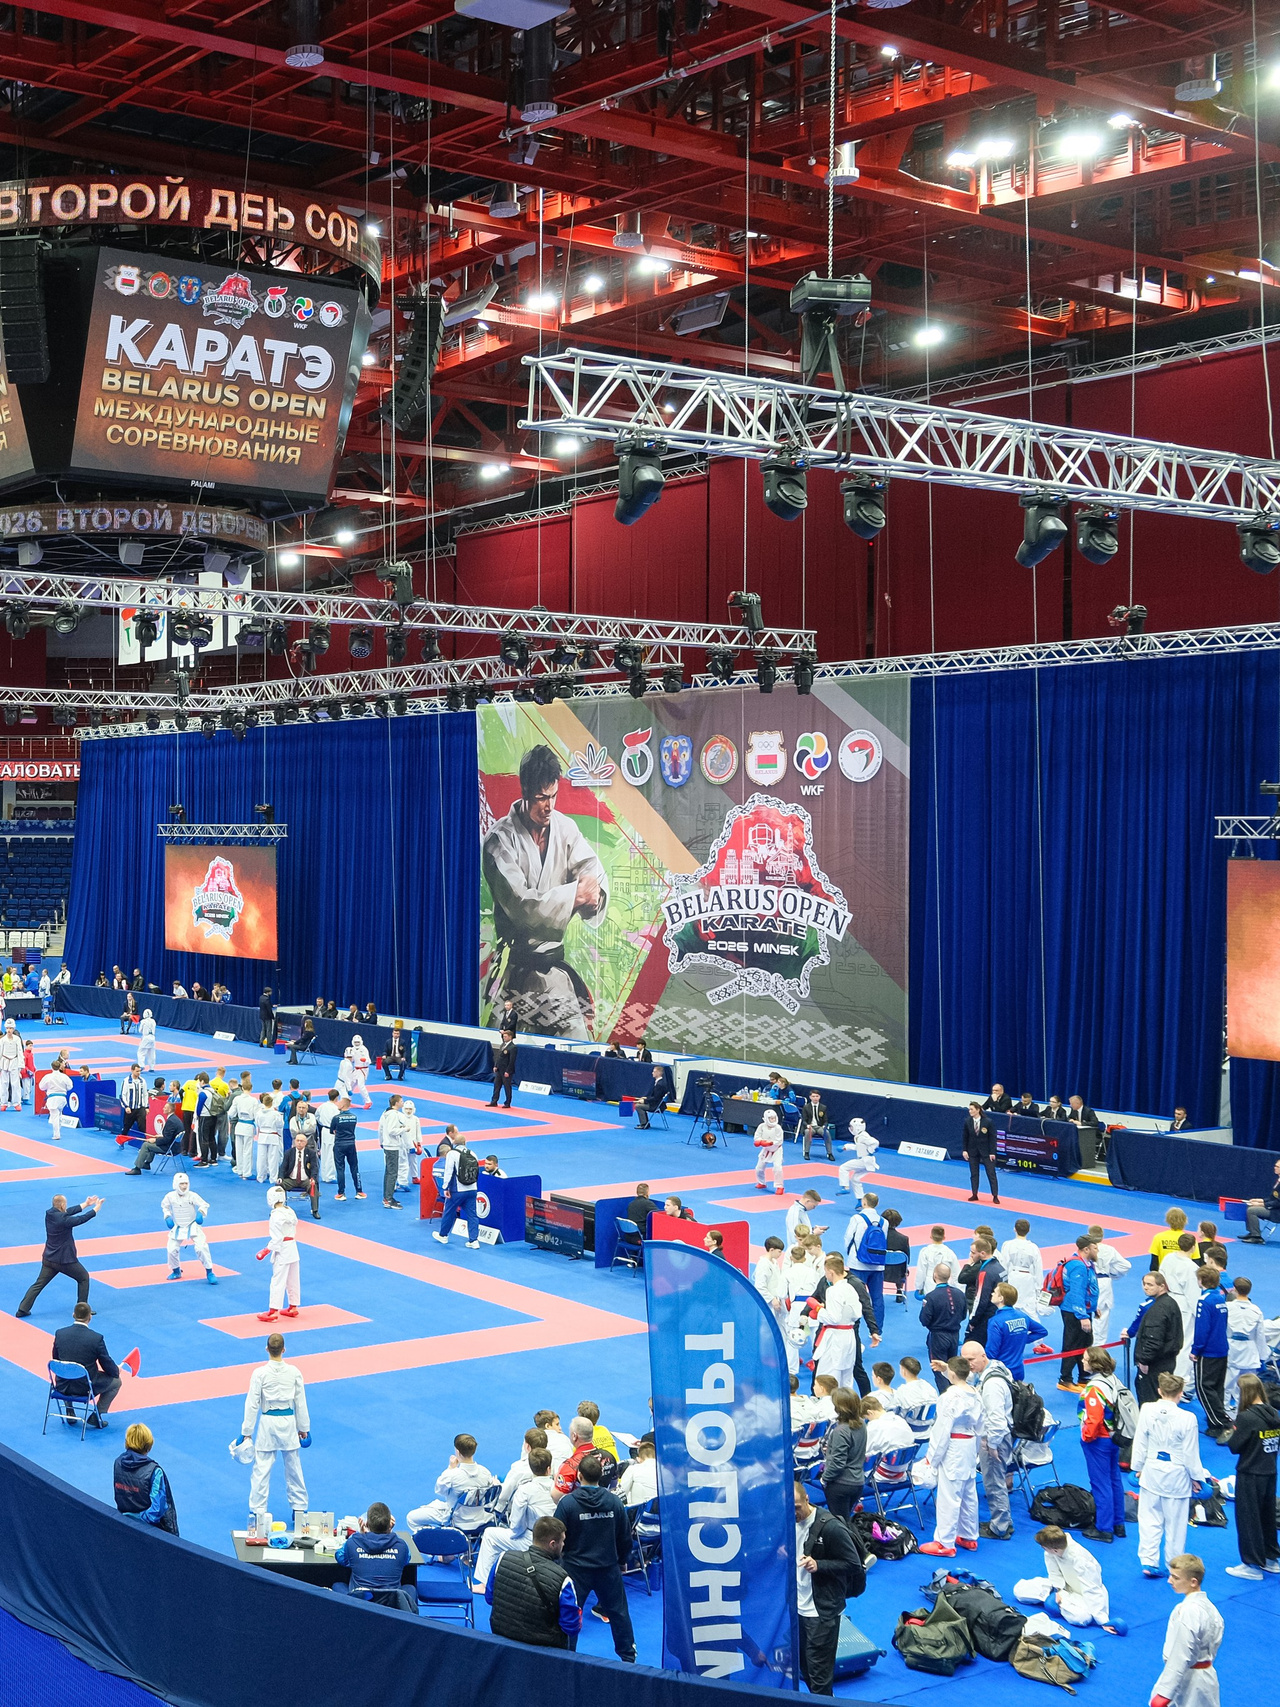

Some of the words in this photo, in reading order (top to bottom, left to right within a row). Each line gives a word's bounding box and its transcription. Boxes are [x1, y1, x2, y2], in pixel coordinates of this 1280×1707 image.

[305, 203, 360, 252] СОР
[104, 314, 336, 394] КАРАТЭ
[101, 368, 241, 409] BELARUS
[249, 388, 327, 419] OPEN
[93, 397, 320, 444] МЕЖДУНАРОДНЫЕ
[106, 424, 302, 465] СОРЕВНОВАНИЯ
[190, 479, 216, 489] PALAMI
[56, 503, 173, 532] ВТОРОЙ
[800, 785, 825, 796] WKF
[665, 888, 775, 926] BELARUS
[782, 892, 848, 936] OPEN
[702, 916, 808, 938] KARATE
[707, 940, 749, 952] 2026
[753, 942, 800, 956] MINSK
[579, 1511, 614, 1521] BELARUS
